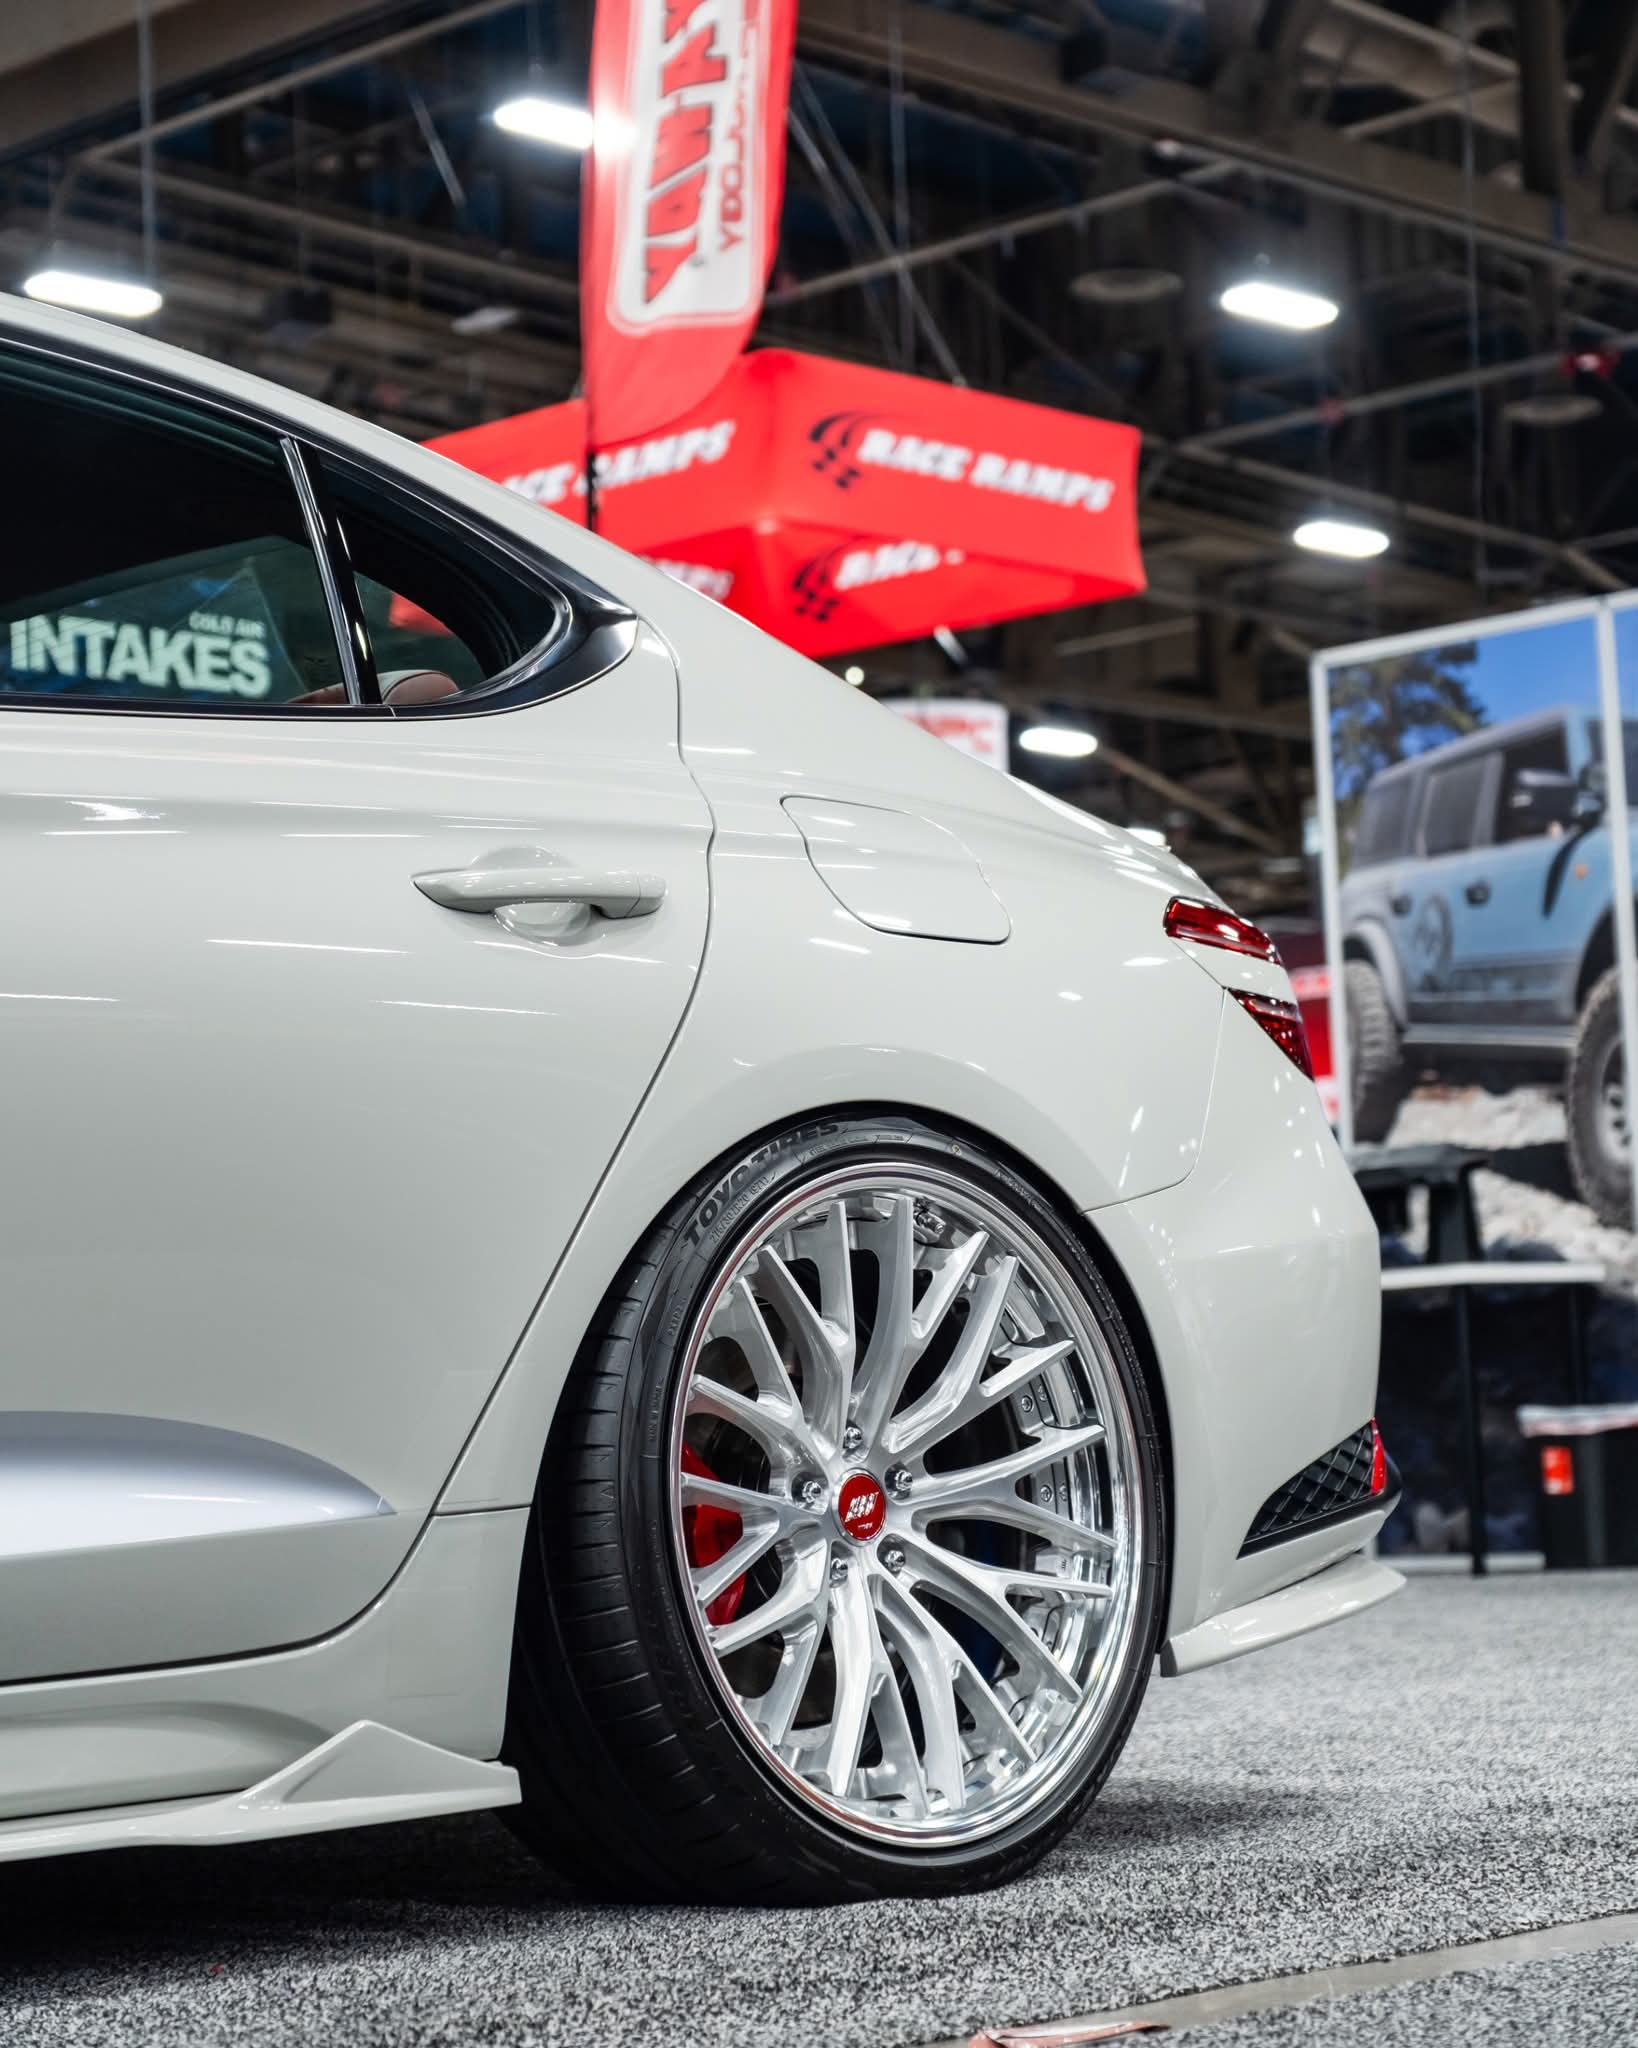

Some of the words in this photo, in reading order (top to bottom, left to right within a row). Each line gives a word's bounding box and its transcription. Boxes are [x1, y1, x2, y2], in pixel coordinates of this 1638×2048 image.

[857, 428, 972, 481] RACE
[969, 452, 1115, 512] RAMPS
[10, 614, 272, 698] INTAKES
[684, 1164, 751, 1247] TOYO
[750, 1122, 839, 1165] TIRES
